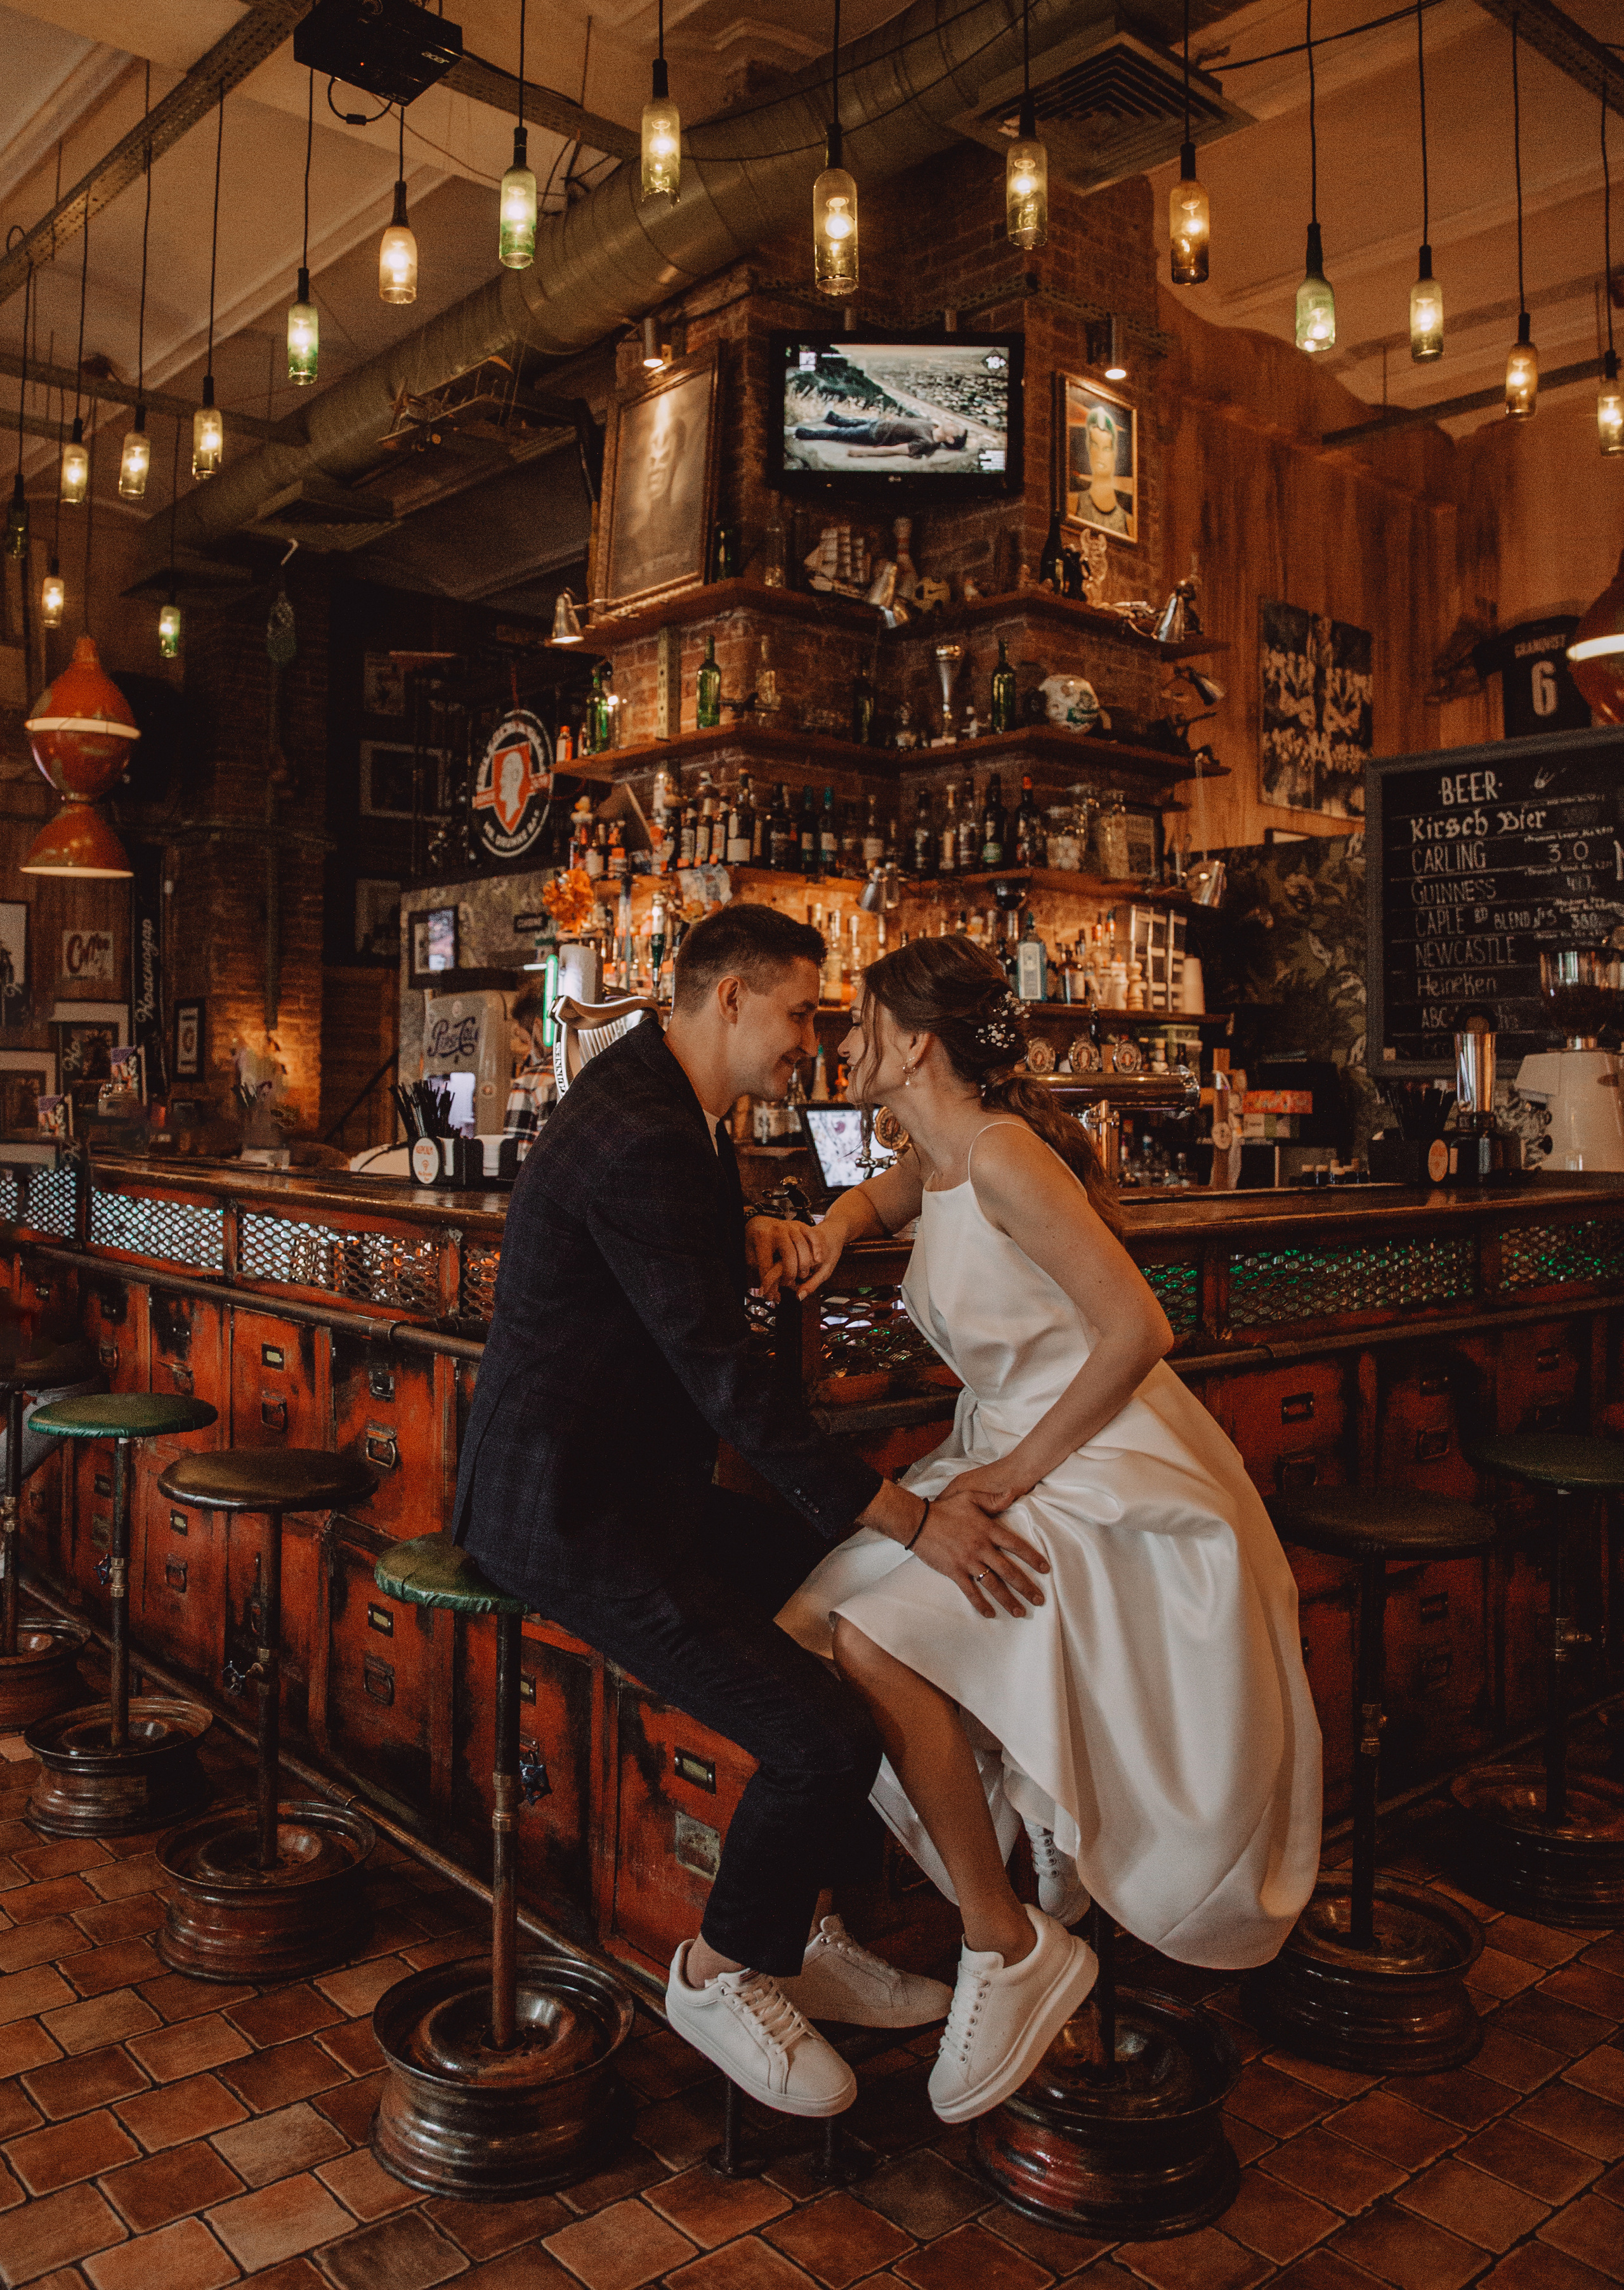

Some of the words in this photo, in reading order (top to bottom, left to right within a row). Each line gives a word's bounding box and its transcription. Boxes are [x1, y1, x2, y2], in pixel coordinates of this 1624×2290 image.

[1531, 660, 1558, 717] 6
[1441, 770, 1499, 806] BEER
[1410, 808, 1488, 843] Kirsch
[1496, 808, 1547, 834] Bier
[1411, 841, 1486, 875] CARLING
[1411, 877, 1496, 906] GUINNESS
[1415, 907, 1465, 937] CAPLE
[1494, 911, 1531, 930] BLEND
[1415, 936, 1517, 967] NEWCASTLE
[555, 1042, 565, 1096] GUINNESS
